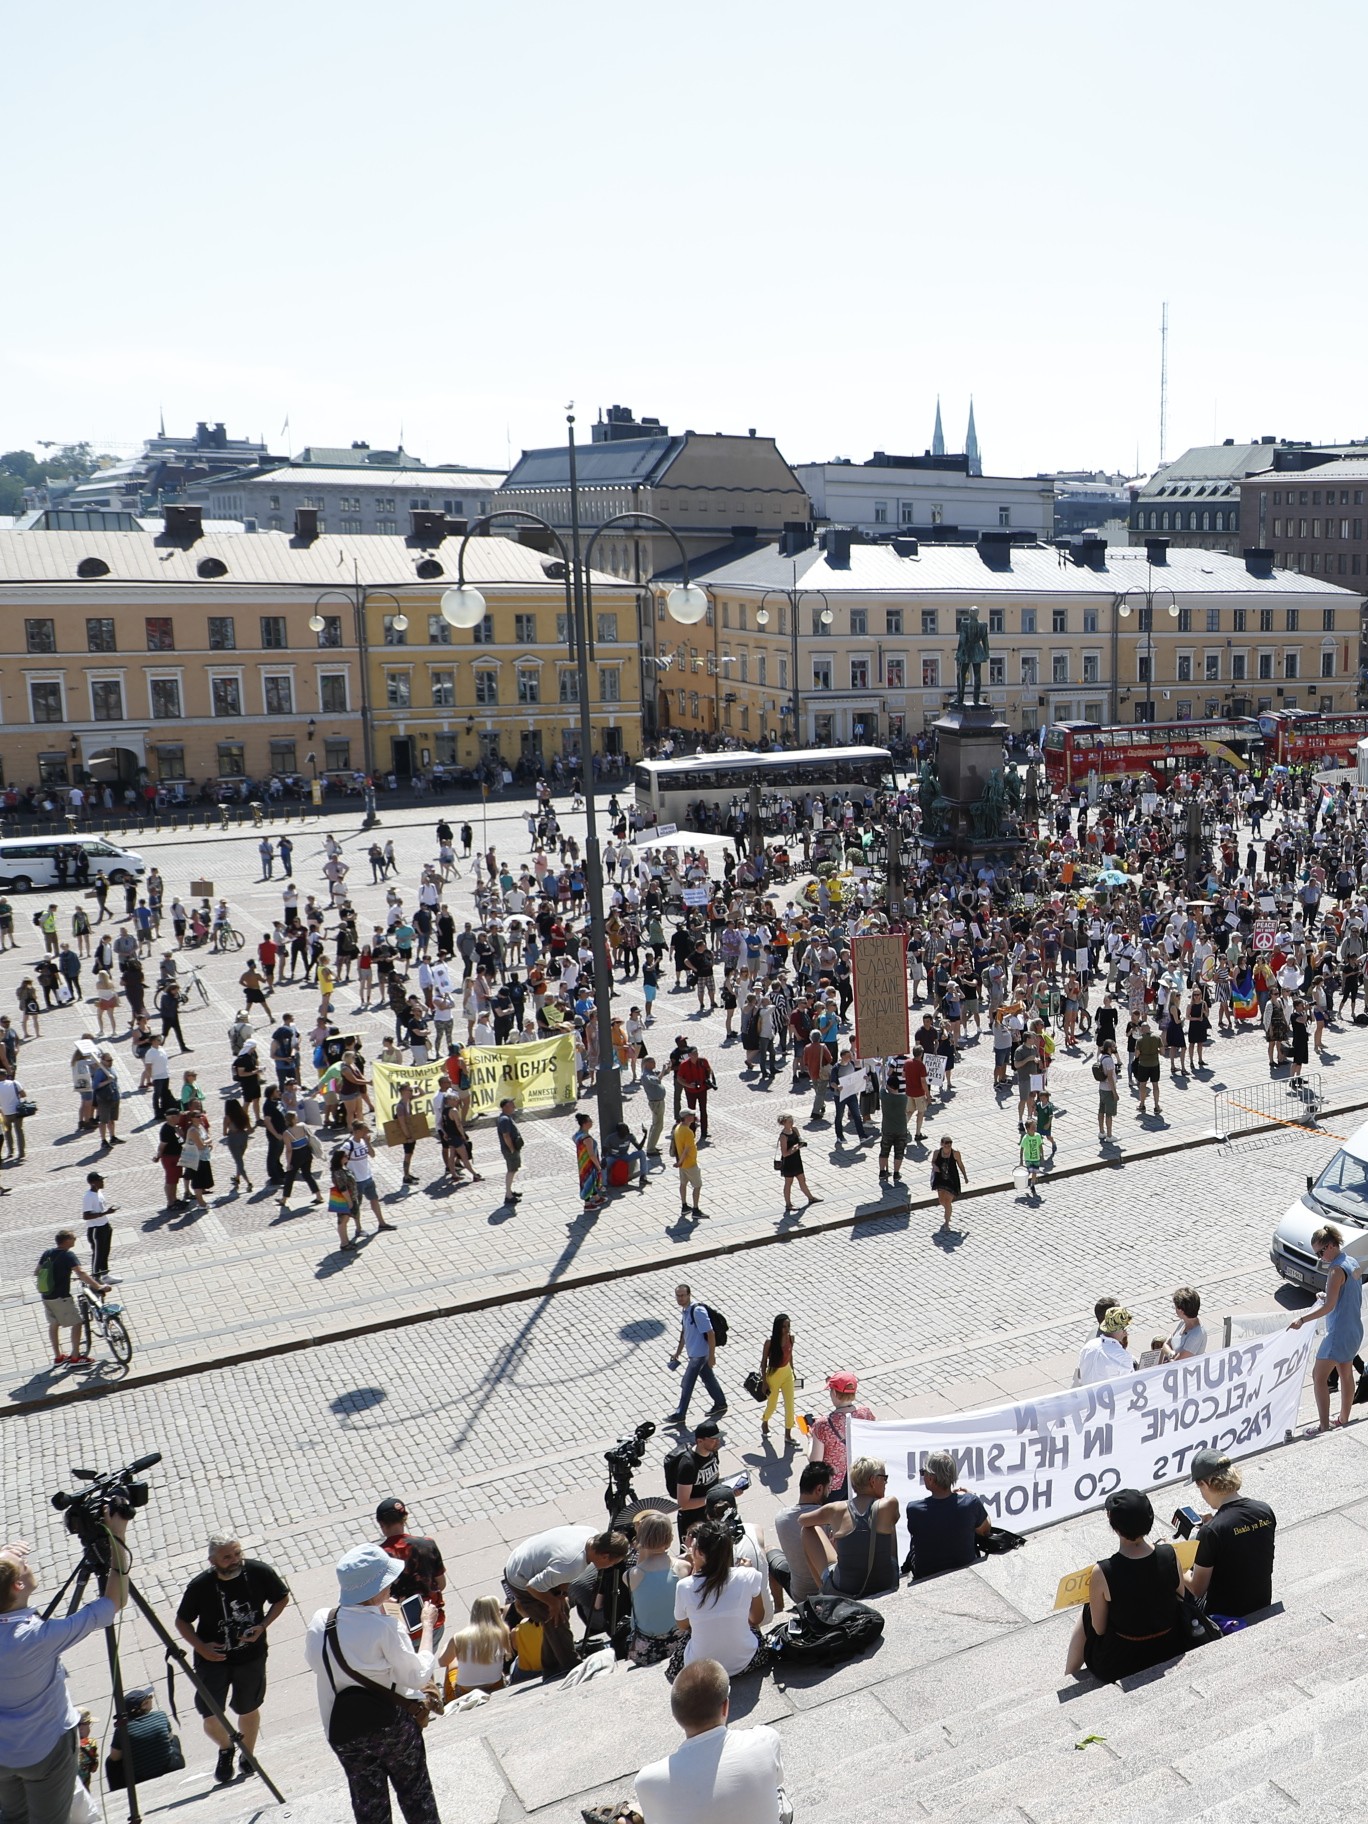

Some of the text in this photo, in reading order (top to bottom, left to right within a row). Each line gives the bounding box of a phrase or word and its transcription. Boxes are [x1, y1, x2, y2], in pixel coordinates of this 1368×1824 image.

[856, 937, 900, 957] RESPECT
[857, 957, 902, 976] СЛАВА
[858, 976, 904, 997] UKRAINE
[502, 1055, 558, 1082] RIGHTS
